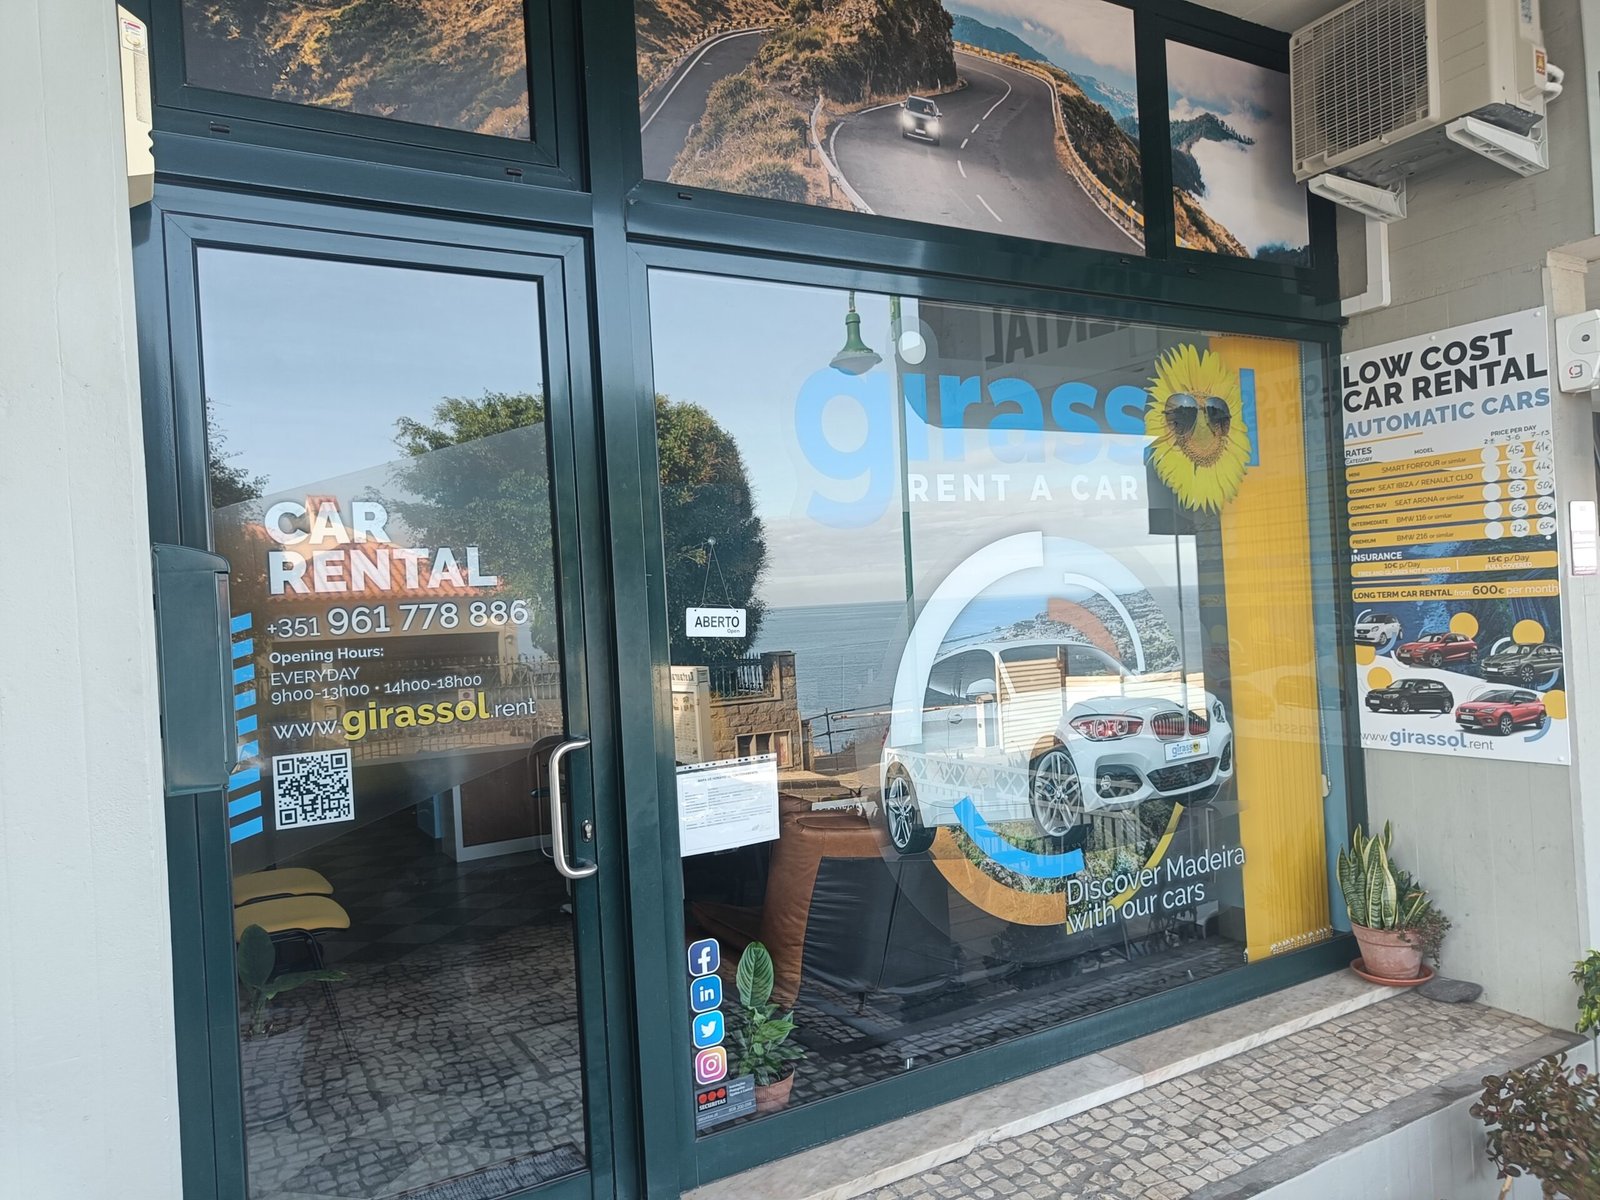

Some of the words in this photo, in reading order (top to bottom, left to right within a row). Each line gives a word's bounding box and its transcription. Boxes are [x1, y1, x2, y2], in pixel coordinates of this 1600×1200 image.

[1343, 351, 1413, 388] LOW
[1420, 329, 1512, 371] COST
[1343, 381, 1402, 412] CAR
[1412, 353, 1548, 401] RENTAL
[1344, 401, 1475, 440] AUTOMATIC
[1481, 387, 1550, 415] CARS
[794, 328, 1259, 530] girassl
[1490, 429, 1509, 437] PRICE
[1510, 426, 1522, 434] PER
[1523, 424, 1537, 432] DAY
[1345, 446, 1373, 458] RATES
[1413, 447, 1435, 455] MODEL
[1507, 445, 1525, 455] 45€
[1534, 441, 1551, 452] 41€
[1345, 456, 1373, 465] CATEGORY
[1381, 465, 1406, 474] SMART
[1406, 459, 1440, 470] FORFOUR
[912, 474, 1010, 502] RENT
[1030, 475, 1053, 501] A
[1070, 474, 1140, 502] CAR
[1378, 482, 1396, 491] SEAT
[1395, 480, 1414, 489] IBIZA
[1421, 474, 1454, 485] RENAULT
[1455, 473, 1474, 482] CLIO
[1536, 480, 1553, 490] 50€
[1349, 486, 1375, 495] ECONOMY
[1509, 484, 1526, 493] 55€
[1412, 495, 1438, 504] ARONA
[1350, 503, 1375, 511] COMPACT
[1511, 503, 1527, 513] 65€
[1537, 501, 1553, 511] 60€
[263, 500, 392, 546] CAR
[1351, 519, 1388, 528] INTERMEDIATE
[1396, 516, 1415, 524] BMW
[1434, 512, 1453, 520] similar
[1539, 521, 1555, 530] 65€
[1352, 538, 1376, 546] PREMIUM
[1396, 534, 1415, 542] BMW
[1415, 532, 1428, 541] 216
[1436, 531, 1455, 539] similar
[1351, 551, 1403, 563] INSURANCE
[1487, 555, 1503, 563] 15€
[1503, 553, 1530, 564] p/Day
[267, 546, 499, 596] RENTAL
[1398, 560, 1421, 570] p/Day
[1378, 591, 1399, 599] TERM
[1400, 590, 1418, 598] CAR
[1419, 588, 1453, 597] RENTAL
[1472, 585, 1505, 595] 600€
[1506, 587, 1523, 595] per
[1524, 583, 1559, 593] month
[267, 617, 321, 638] +351
[327, 604, 391, 634] 961
[399, 603, 459, 631] 778
[469, 600, 530, 627] 886
[694, 616, 740, 628] ABERTO
[269, 649, 335, 666] Opening
[337, 646, 385, 662] Hours:
[270, 667, 361, 686] EVERYDAY
[271, 684, 371, 706] 9h00-13h00
[383, 674, 483, 695] 14h00-18h00
[272, 691, 537, 741] www.girassol.rent
[1361, 728, 1494, 751] www.girassol.rent
[1067, 865, 1161, 906] Discover
[1166, 845, 1246, 882] Madeira
[1068, 898, 1116, 934] with
[1121, 893, 1158, 920] our
[1162, 881, 1206, 910] cars
[699, 1098, 726, 1111] SECURITAS
